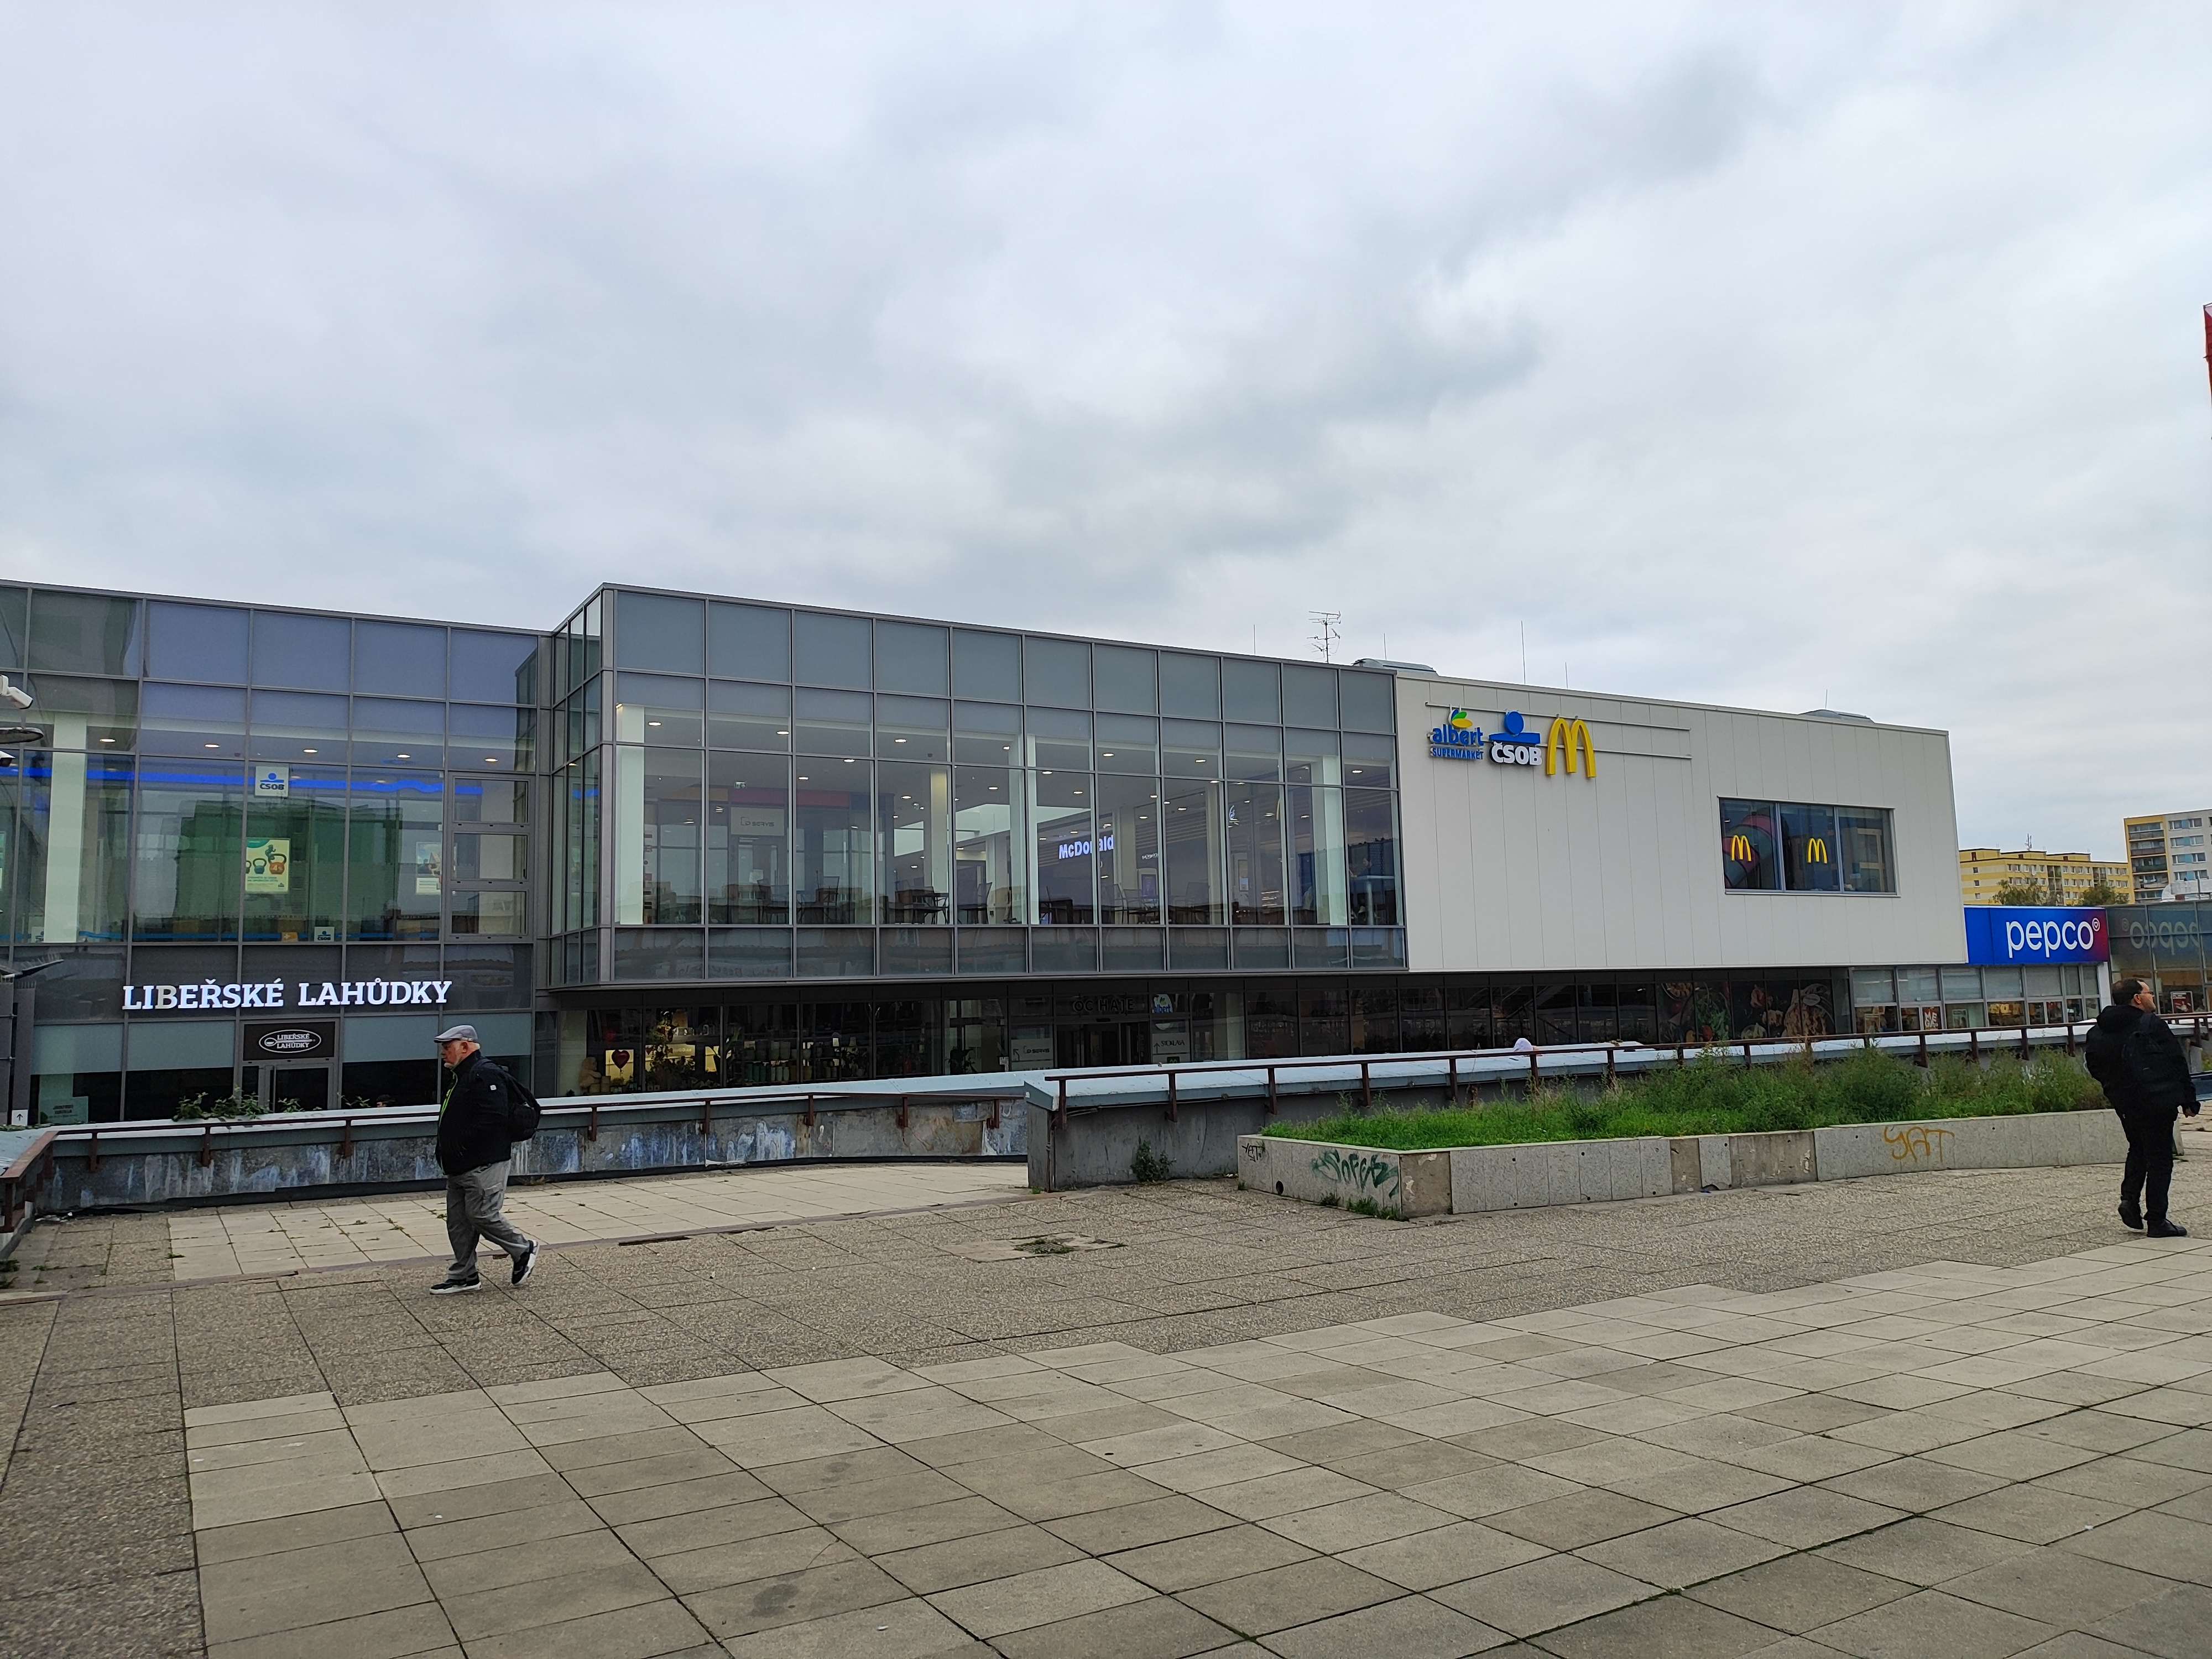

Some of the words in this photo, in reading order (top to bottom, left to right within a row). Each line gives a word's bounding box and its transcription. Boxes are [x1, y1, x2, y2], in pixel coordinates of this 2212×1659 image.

[1430, 723, 1484, 746] albert
[1431, 747, 1484, 760] SUPERMARKET
[1491, 741, 1542, 765] ČSOB
[1058, 834, 1114, 859] McDoald
[2006, 920, 2094, 958] pepco
[122, 977, 284, 1010] LIBEŘSKÉ
[298, 977, 453, 1006] LAHŮDKY
